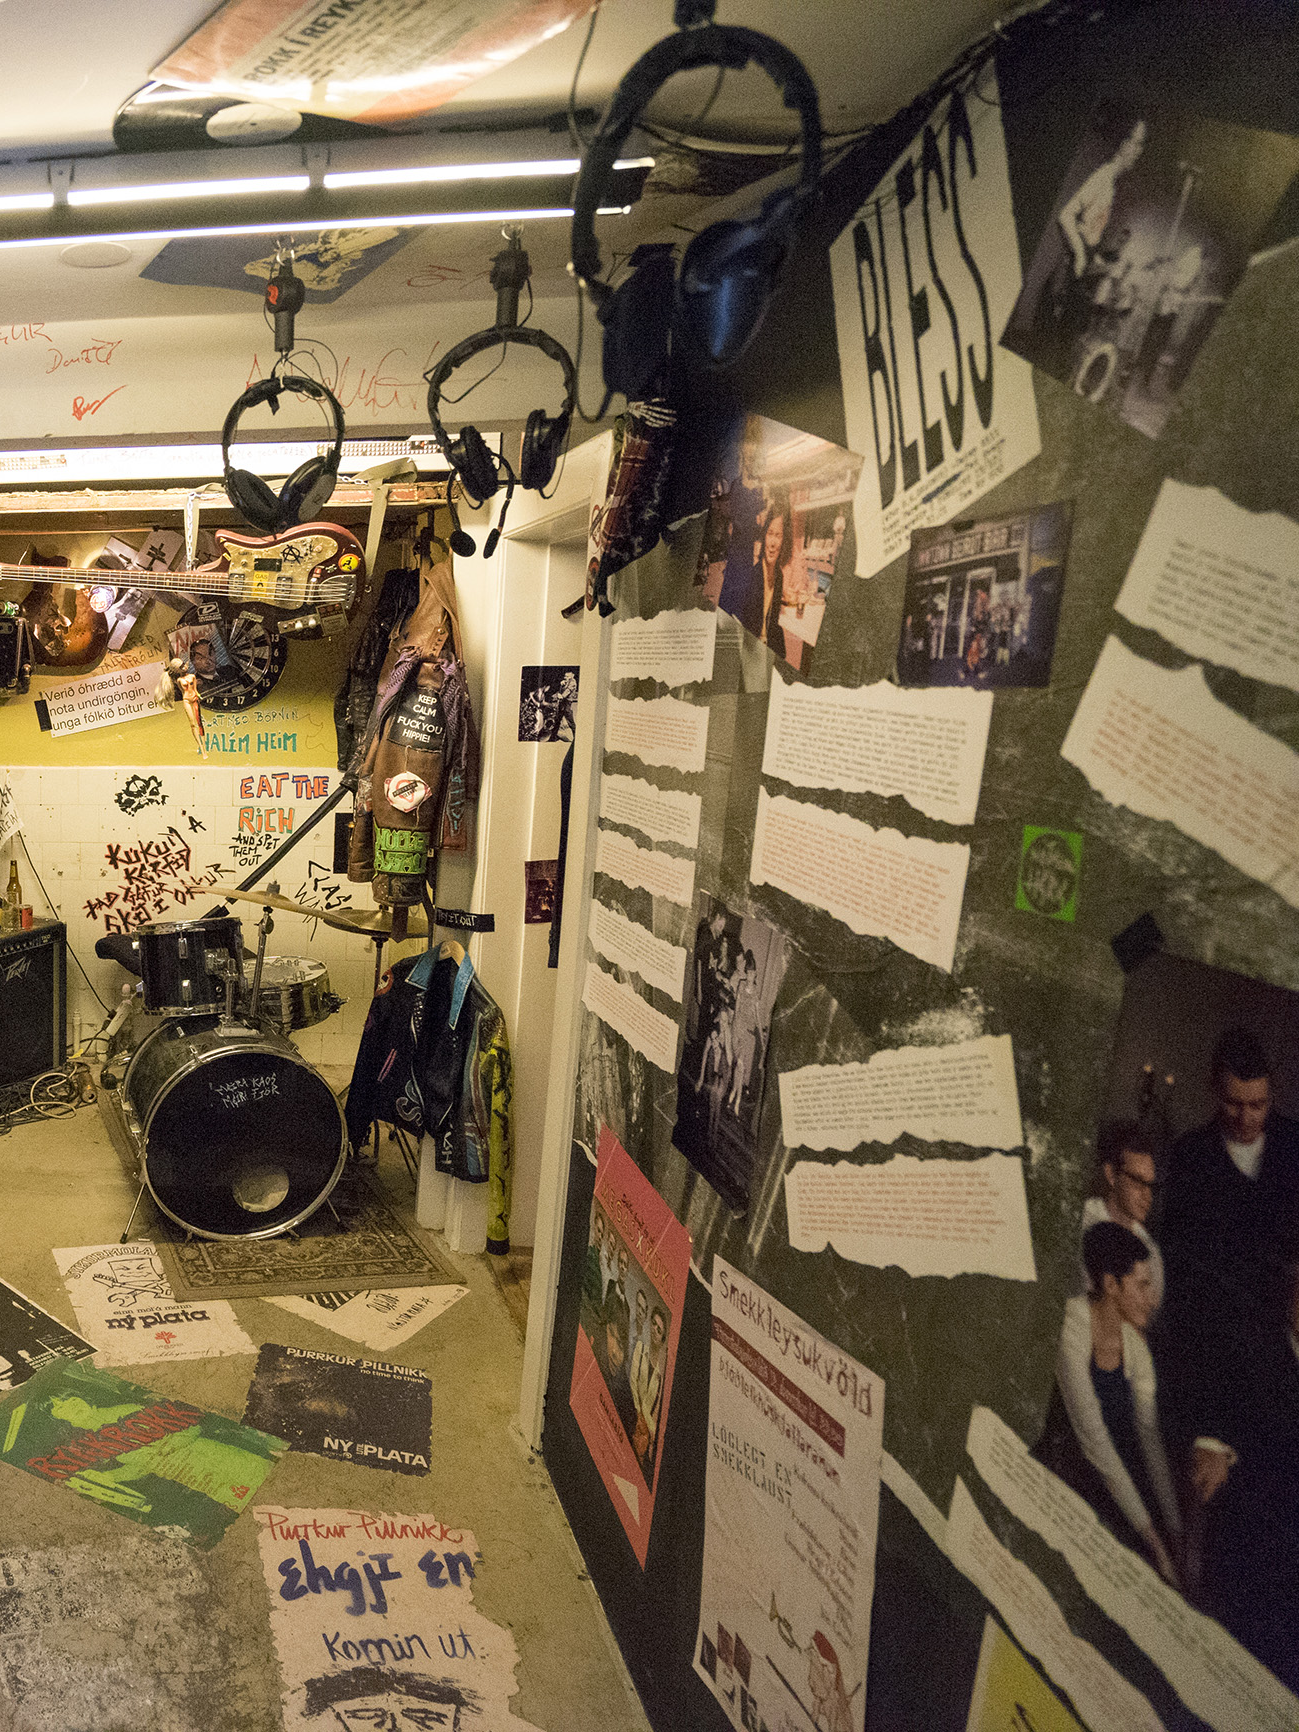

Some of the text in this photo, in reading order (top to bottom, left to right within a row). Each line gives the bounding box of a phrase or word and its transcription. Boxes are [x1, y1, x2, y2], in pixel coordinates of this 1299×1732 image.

[853, 90, 994, 510] BLESS
[45, 671, 142, 702] Verið óhrædd að
[49, 686, 150, 717] nota undirgöngin,
[413, 704, 437, 718] CALM
[418, 694, 437, 706] KEEP
[52, 718, 81, 732] unga
[84, 707, 115, 724] fólkið
[118, 701, 144, 716] bítur
[397, 715, 443, 735] FUCK YOU
[402, 728, 431, 744] HIPPIE!
[240, 773, 329, 799] EAT THE
[239, 855, 262, 867] OUT
[66, 1244, 158, 1280] SYKURMOLA
[164, 1303, 193, 1312] mann
[105, 1309, 212, 1331] ný plata
[287, 1347, 429, 1380] PURRKUR PILLNIKK
[372, 1369, 391, 1379] time
[393, 1373, 403, 1381] to
[404, 1374, 426, 1385] think
[364, 1444, 429, 1469] PLATA
